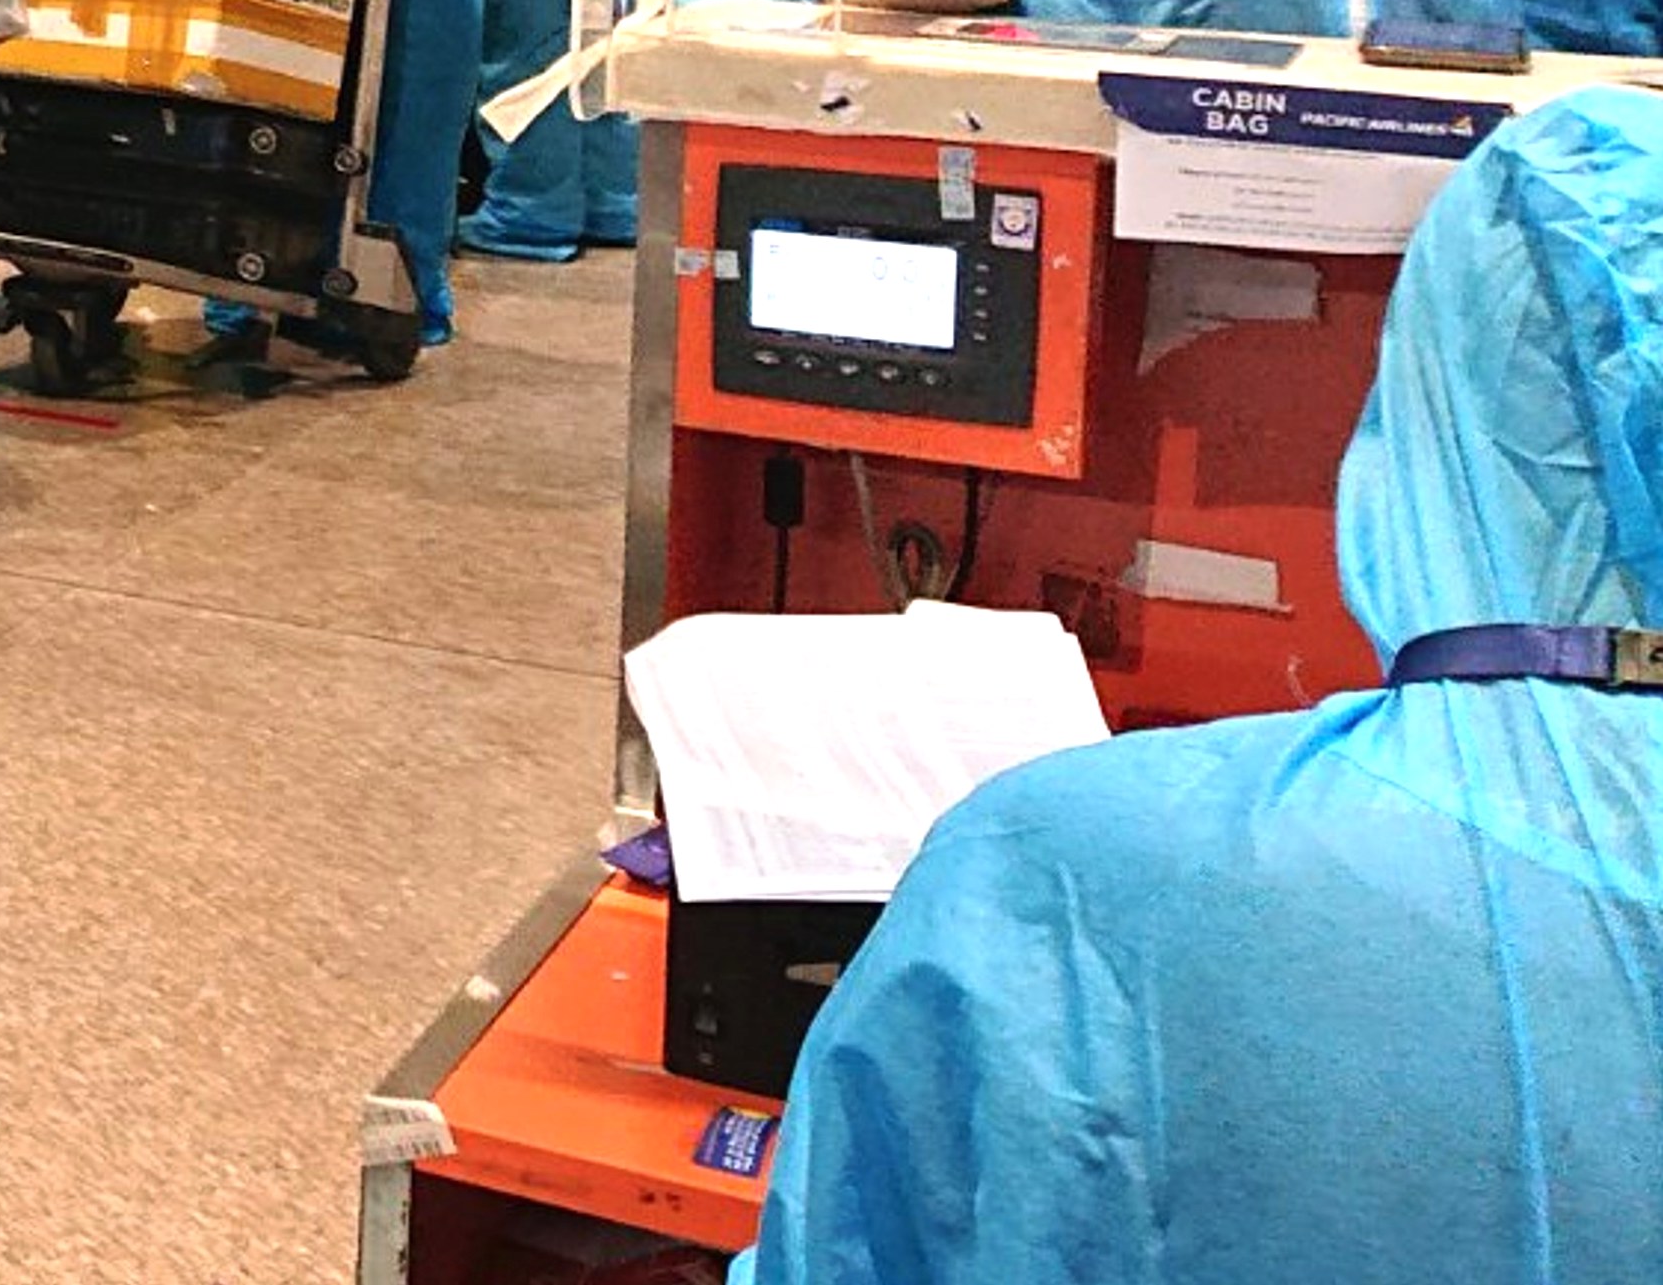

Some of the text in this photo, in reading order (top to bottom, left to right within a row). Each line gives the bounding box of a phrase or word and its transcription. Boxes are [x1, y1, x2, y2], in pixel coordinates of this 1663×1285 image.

[1192, 87, 1287, 114] CABIN
[1206, 113, 1270, 135] BAG
[1300, 112, 1448, 136] PACIFIC AIRLINES
